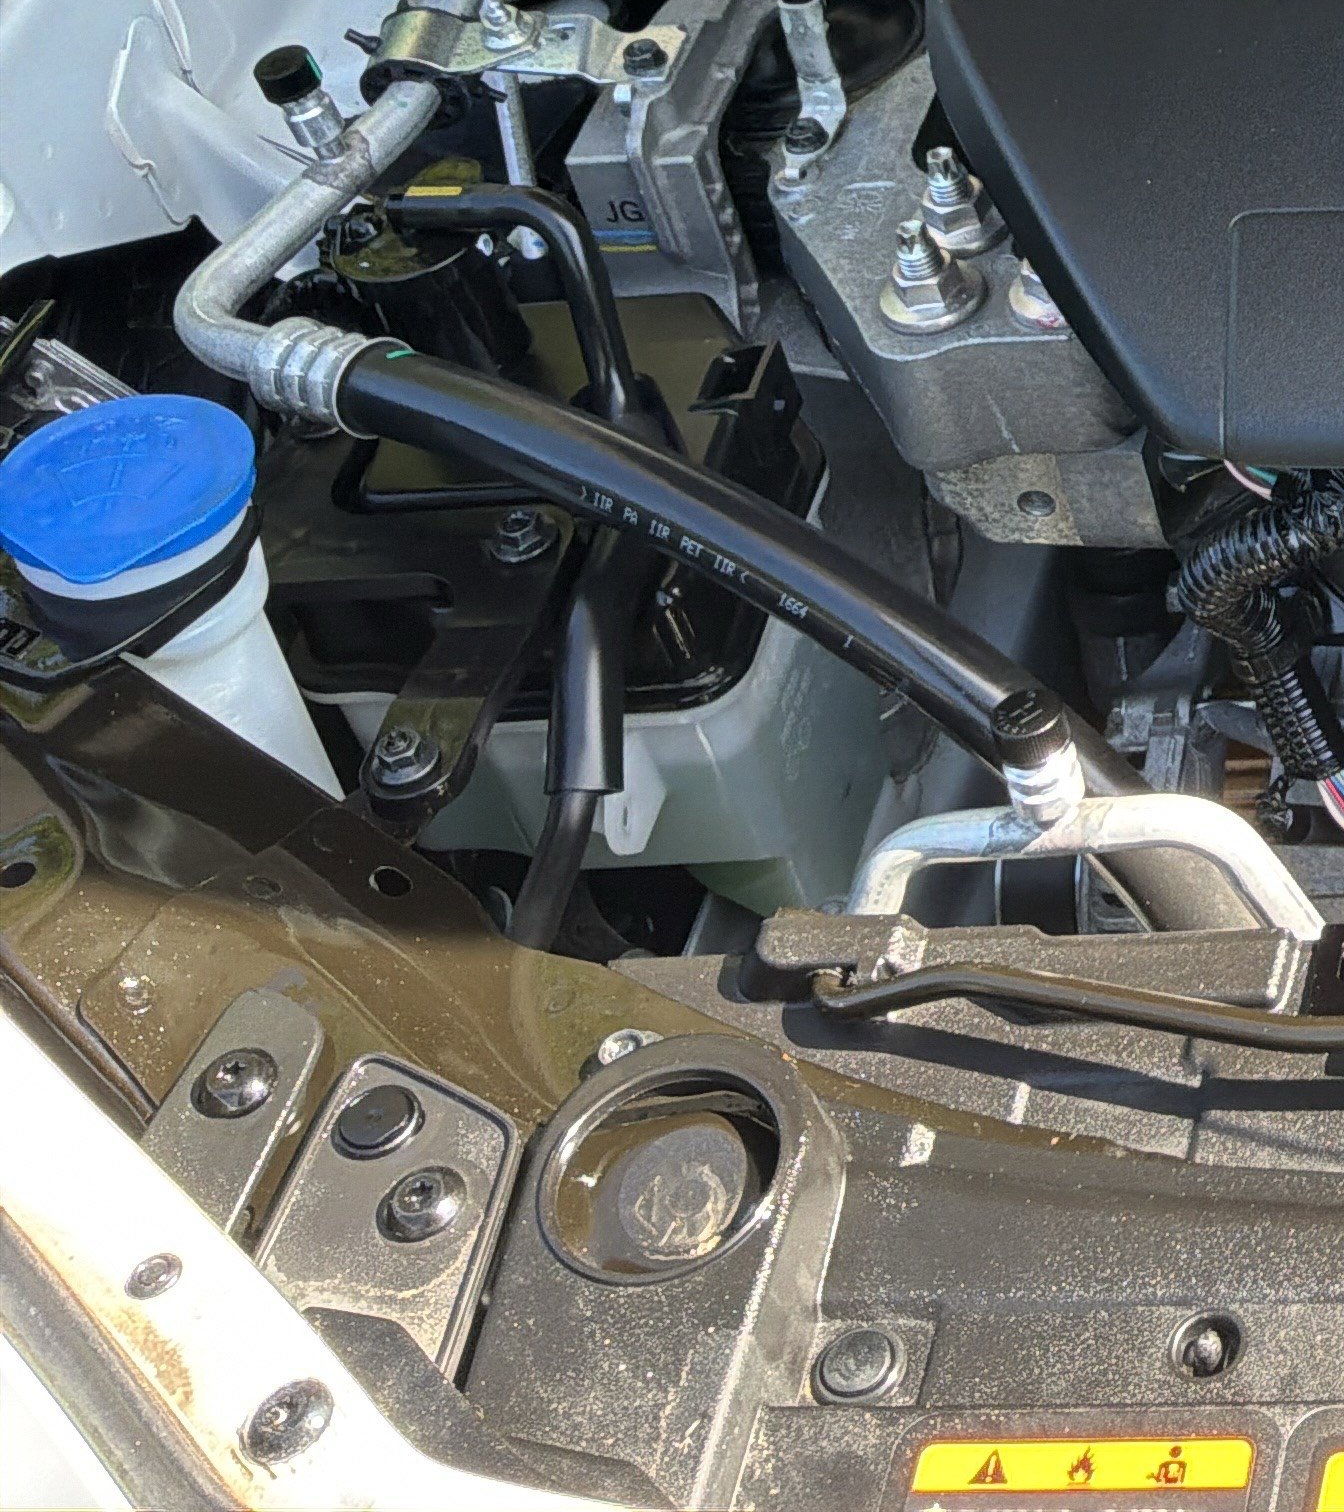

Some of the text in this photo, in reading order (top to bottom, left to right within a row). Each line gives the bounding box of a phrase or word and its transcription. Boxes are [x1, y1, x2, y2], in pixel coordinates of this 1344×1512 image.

[606, 199, 646, 223] JG
[622, 506, 639, 526] PA
[649, 519, 671, 541] IIR
[679, 535, 704, 558] PET
[778, 592, 809, 619] 1664
